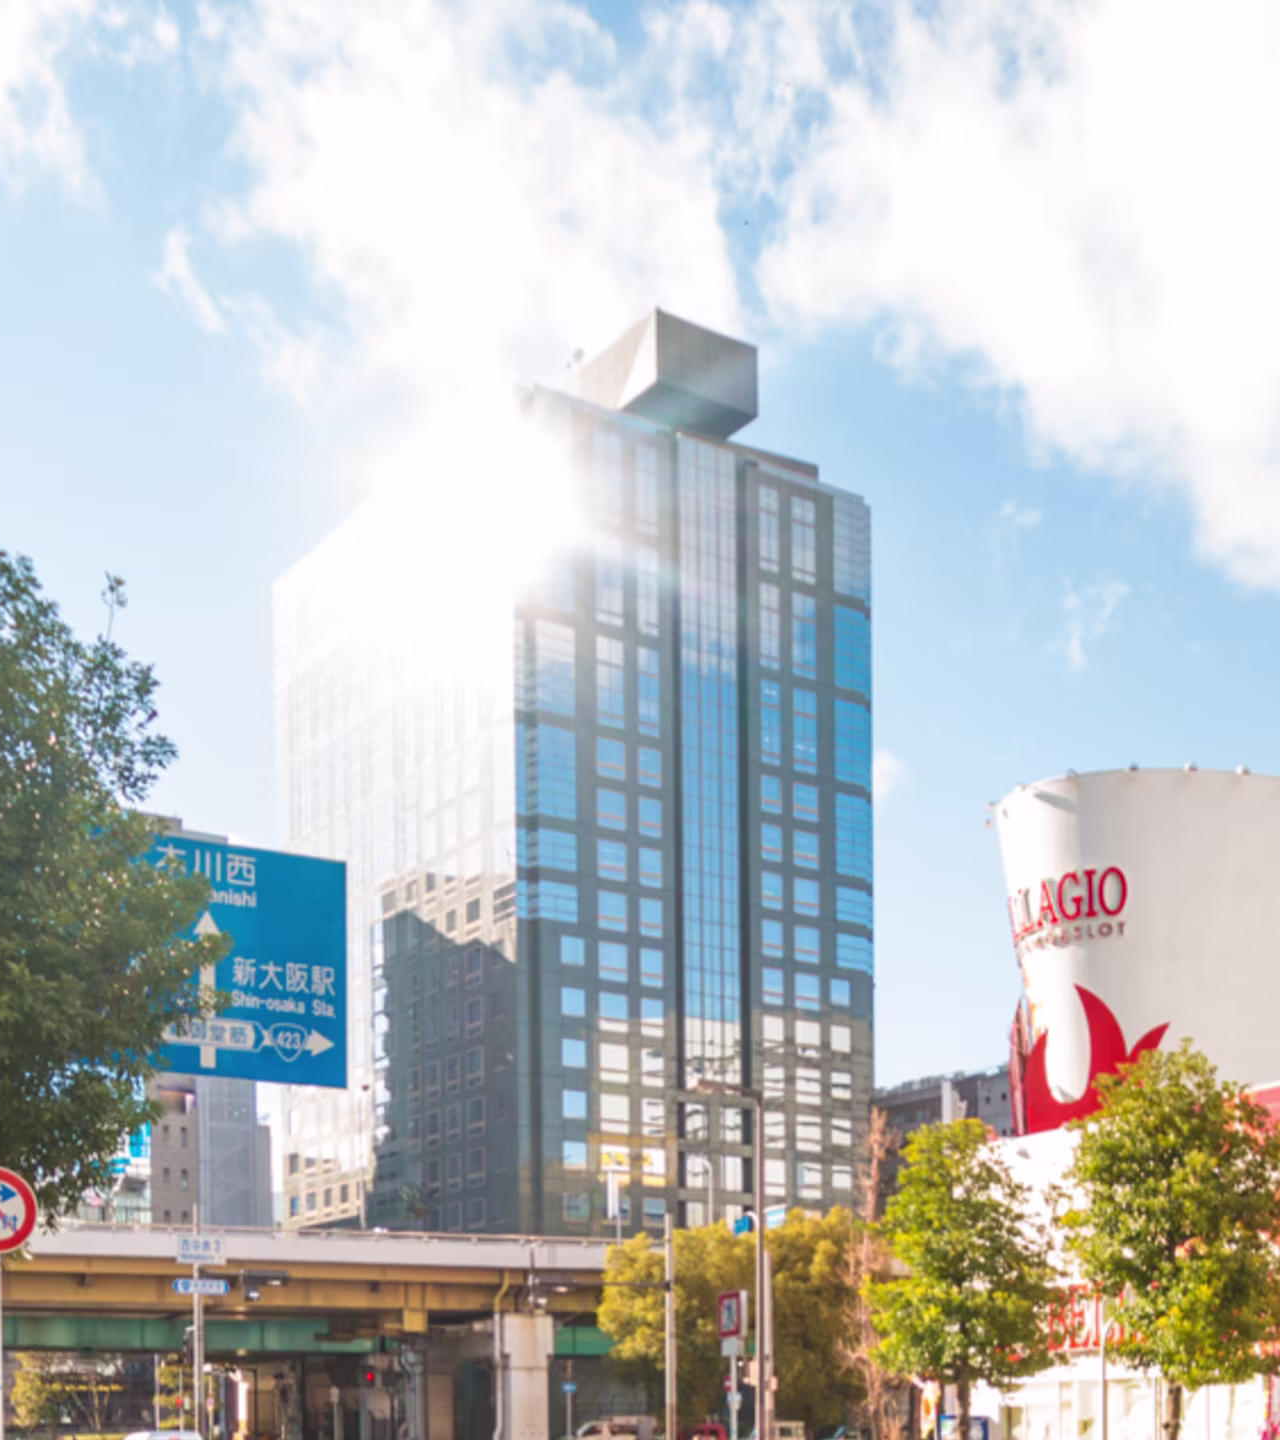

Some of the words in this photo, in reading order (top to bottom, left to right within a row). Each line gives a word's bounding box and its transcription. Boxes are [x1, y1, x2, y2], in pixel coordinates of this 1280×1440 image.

[232, 956, 336, 997] 新大阪駅
[277, 1030, 301, 1049] 423
